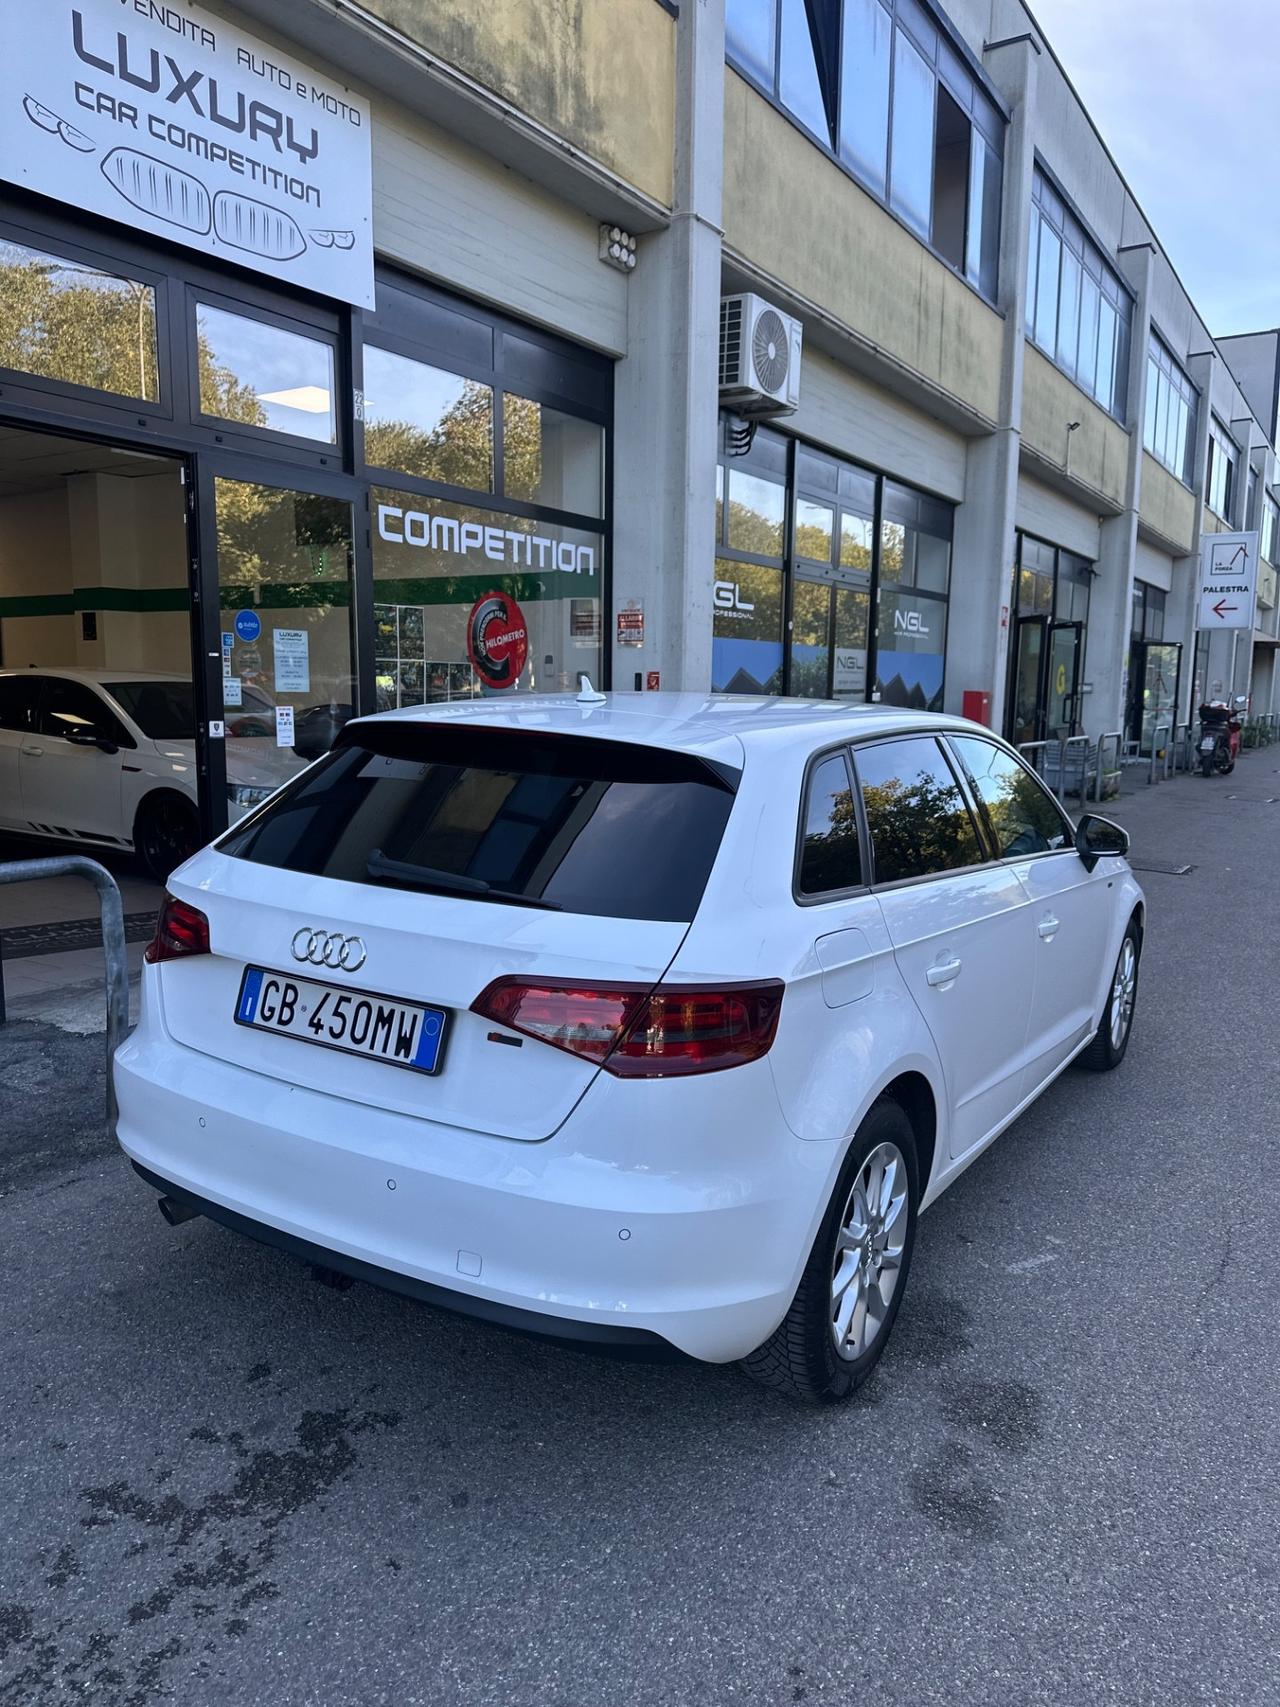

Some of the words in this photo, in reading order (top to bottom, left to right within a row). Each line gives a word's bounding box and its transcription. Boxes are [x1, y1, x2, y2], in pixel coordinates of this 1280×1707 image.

[72, 9, 319, 165] LUXURY
[121, 0, 216, 52] ENDITA
[237, 47, 291, 91] AUTO
[296, 82, 307, 99] e
[311, 86, 361, 127] MOTO
[74, 81, 138, 129] CAR
[148, 113, 321, 208] COMPETITION
[377, 504, 594, 576] COMPETITION
[713, 581, 755, 610] GL
[893, 609, 929, 633] NGL
[1203, 585, 1249, 593] PALESTRA
[836, 655, 864, 669] NGL
[260, 979, 299, 1027] GB
[308, 992, 419, 1059] 450MW
